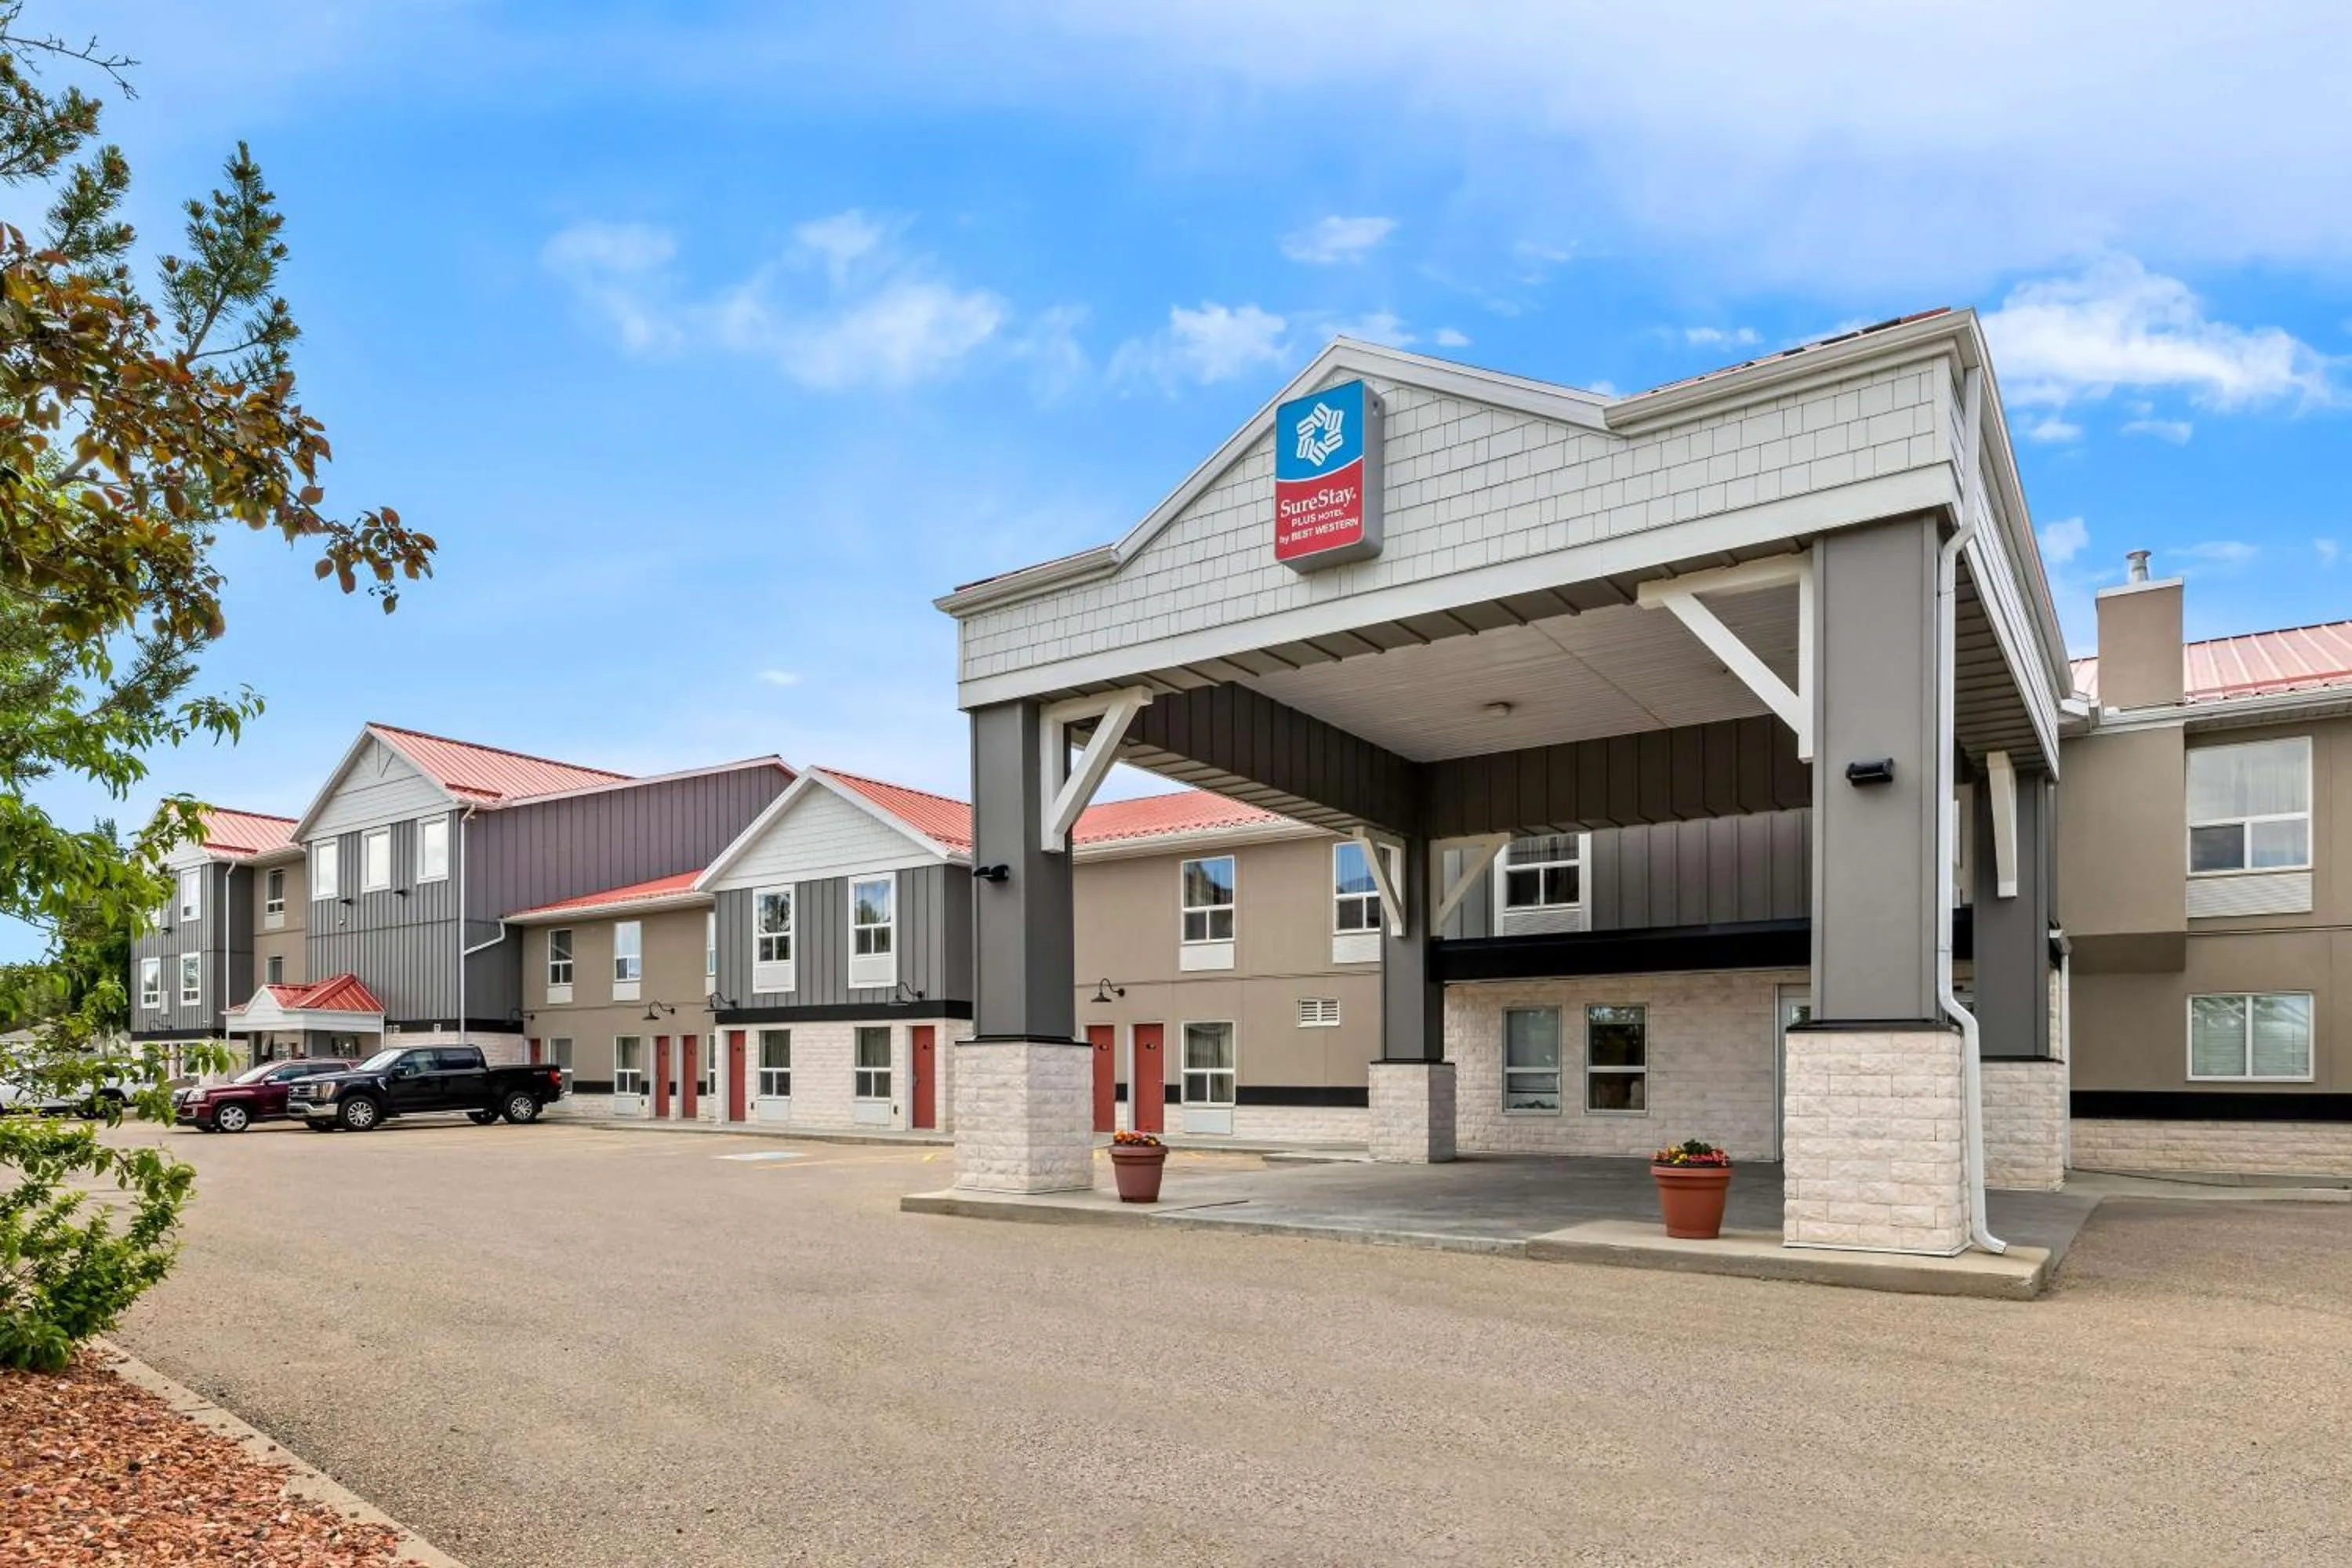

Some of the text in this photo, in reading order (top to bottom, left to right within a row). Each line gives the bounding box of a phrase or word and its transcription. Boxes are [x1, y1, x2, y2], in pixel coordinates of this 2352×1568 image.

[1291, 514, 1316, 527] PLUS
[1279, 517, 1359, 546] by BEST WESTERN
